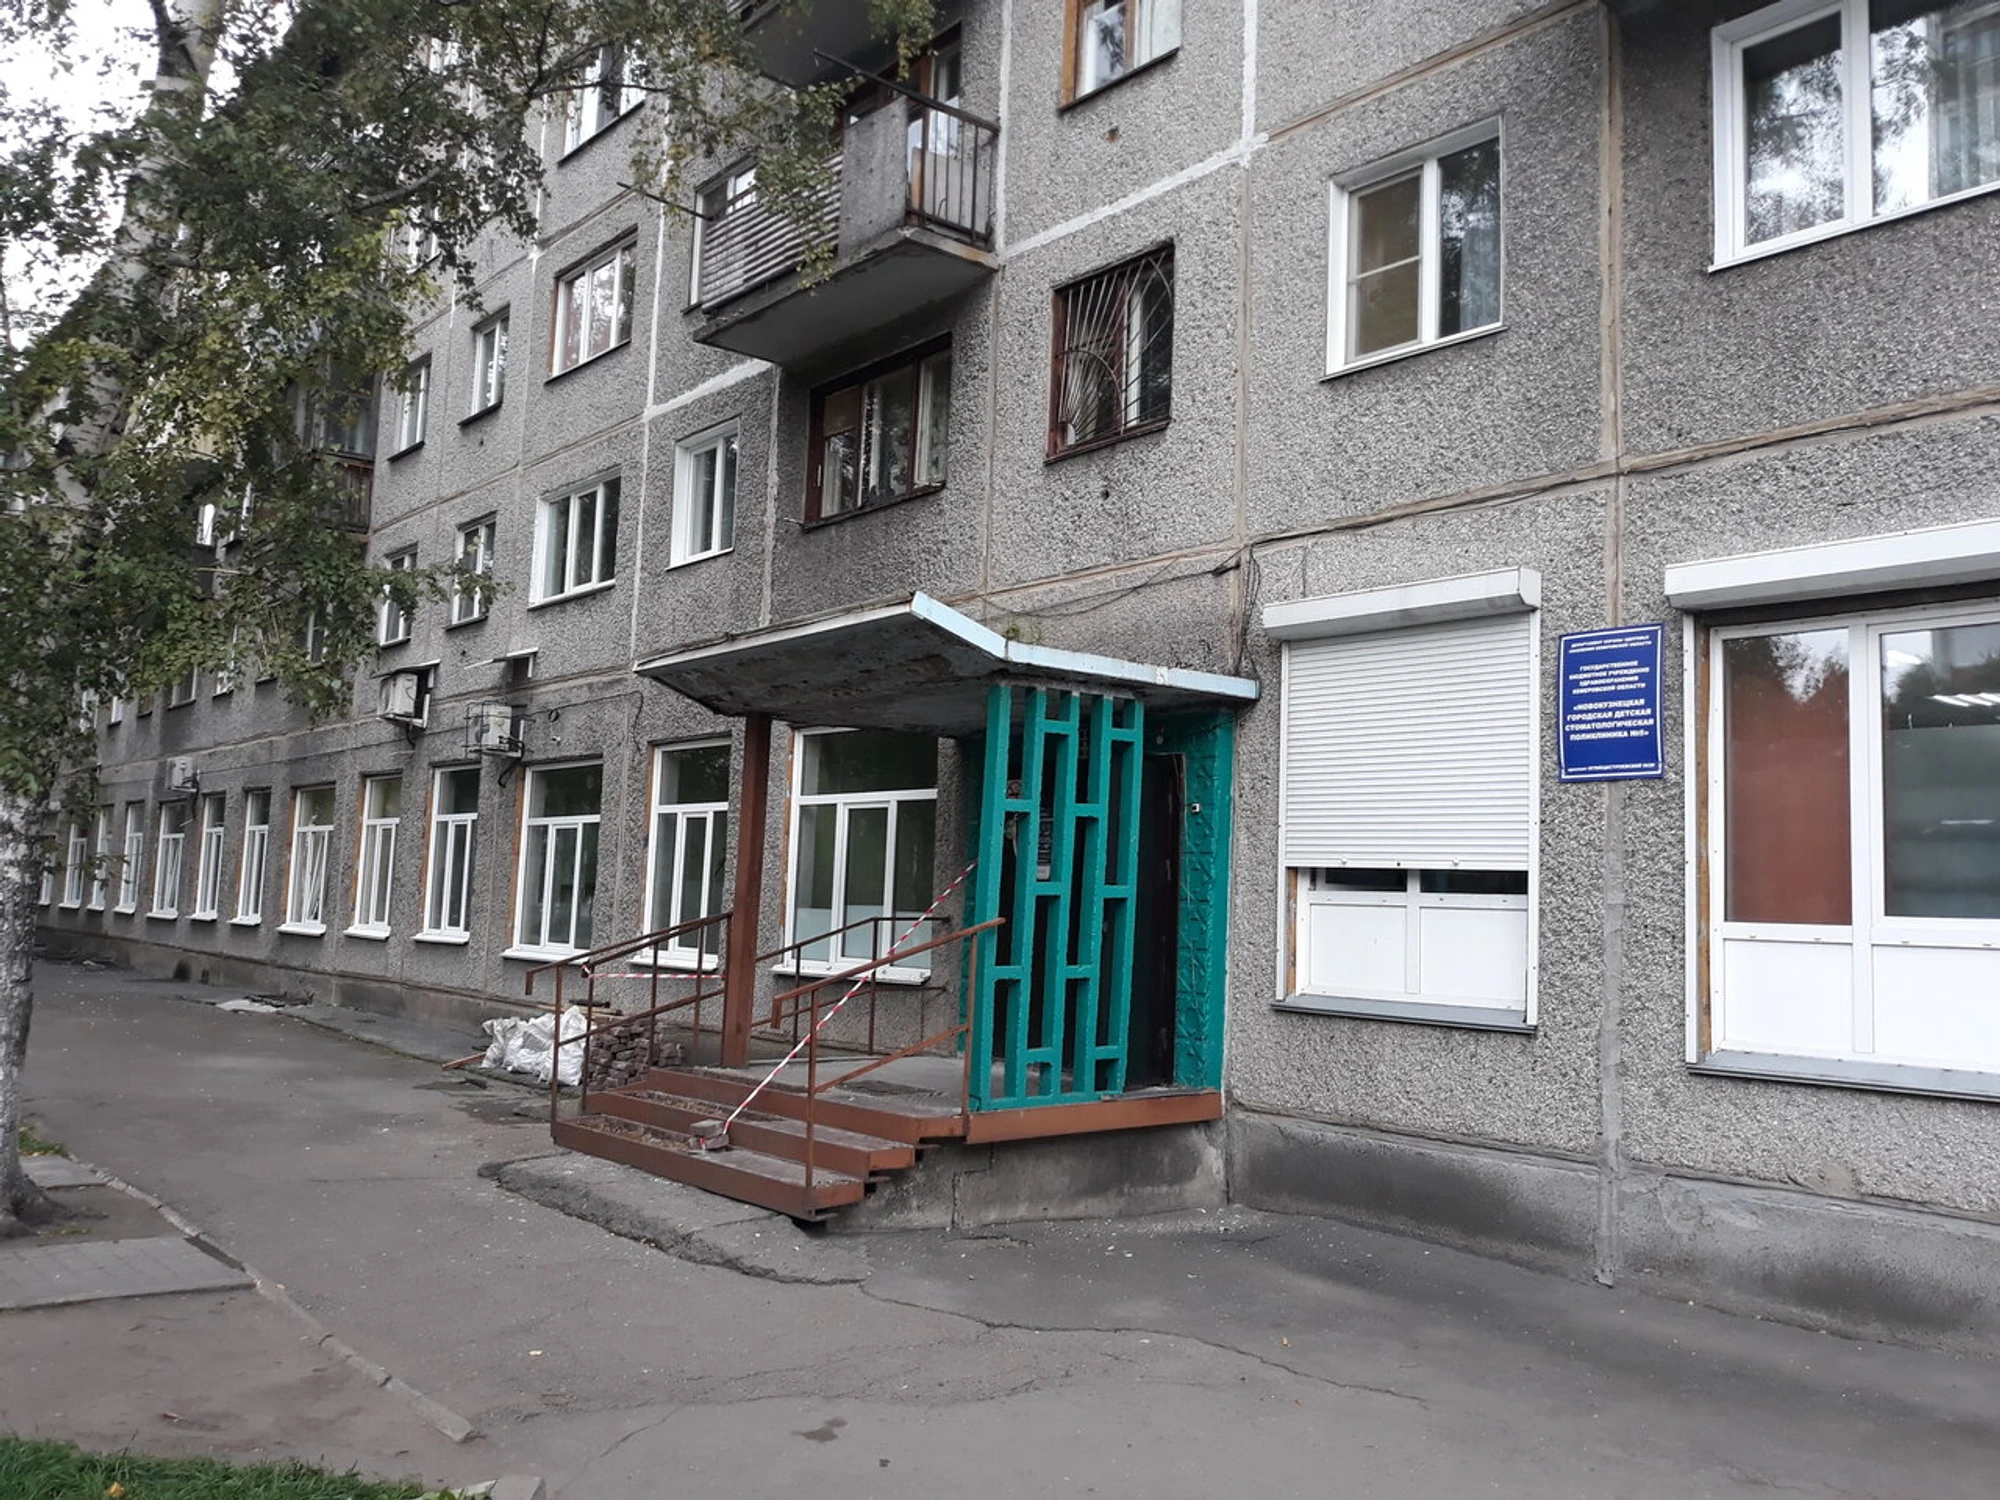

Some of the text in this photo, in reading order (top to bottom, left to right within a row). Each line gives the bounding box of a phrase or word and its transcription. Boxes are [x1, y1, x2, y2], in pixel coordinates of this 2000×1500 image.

[1567, 708, 1652, 721] ГОРОДСКАЯ ДЕТСКАЯ
[1565, 718, 1655, 731] СТОМАТОЛОГИЧЕСКАЯ
[1569, 730, 1629, 741] ПОЛИКЛИНИКА
